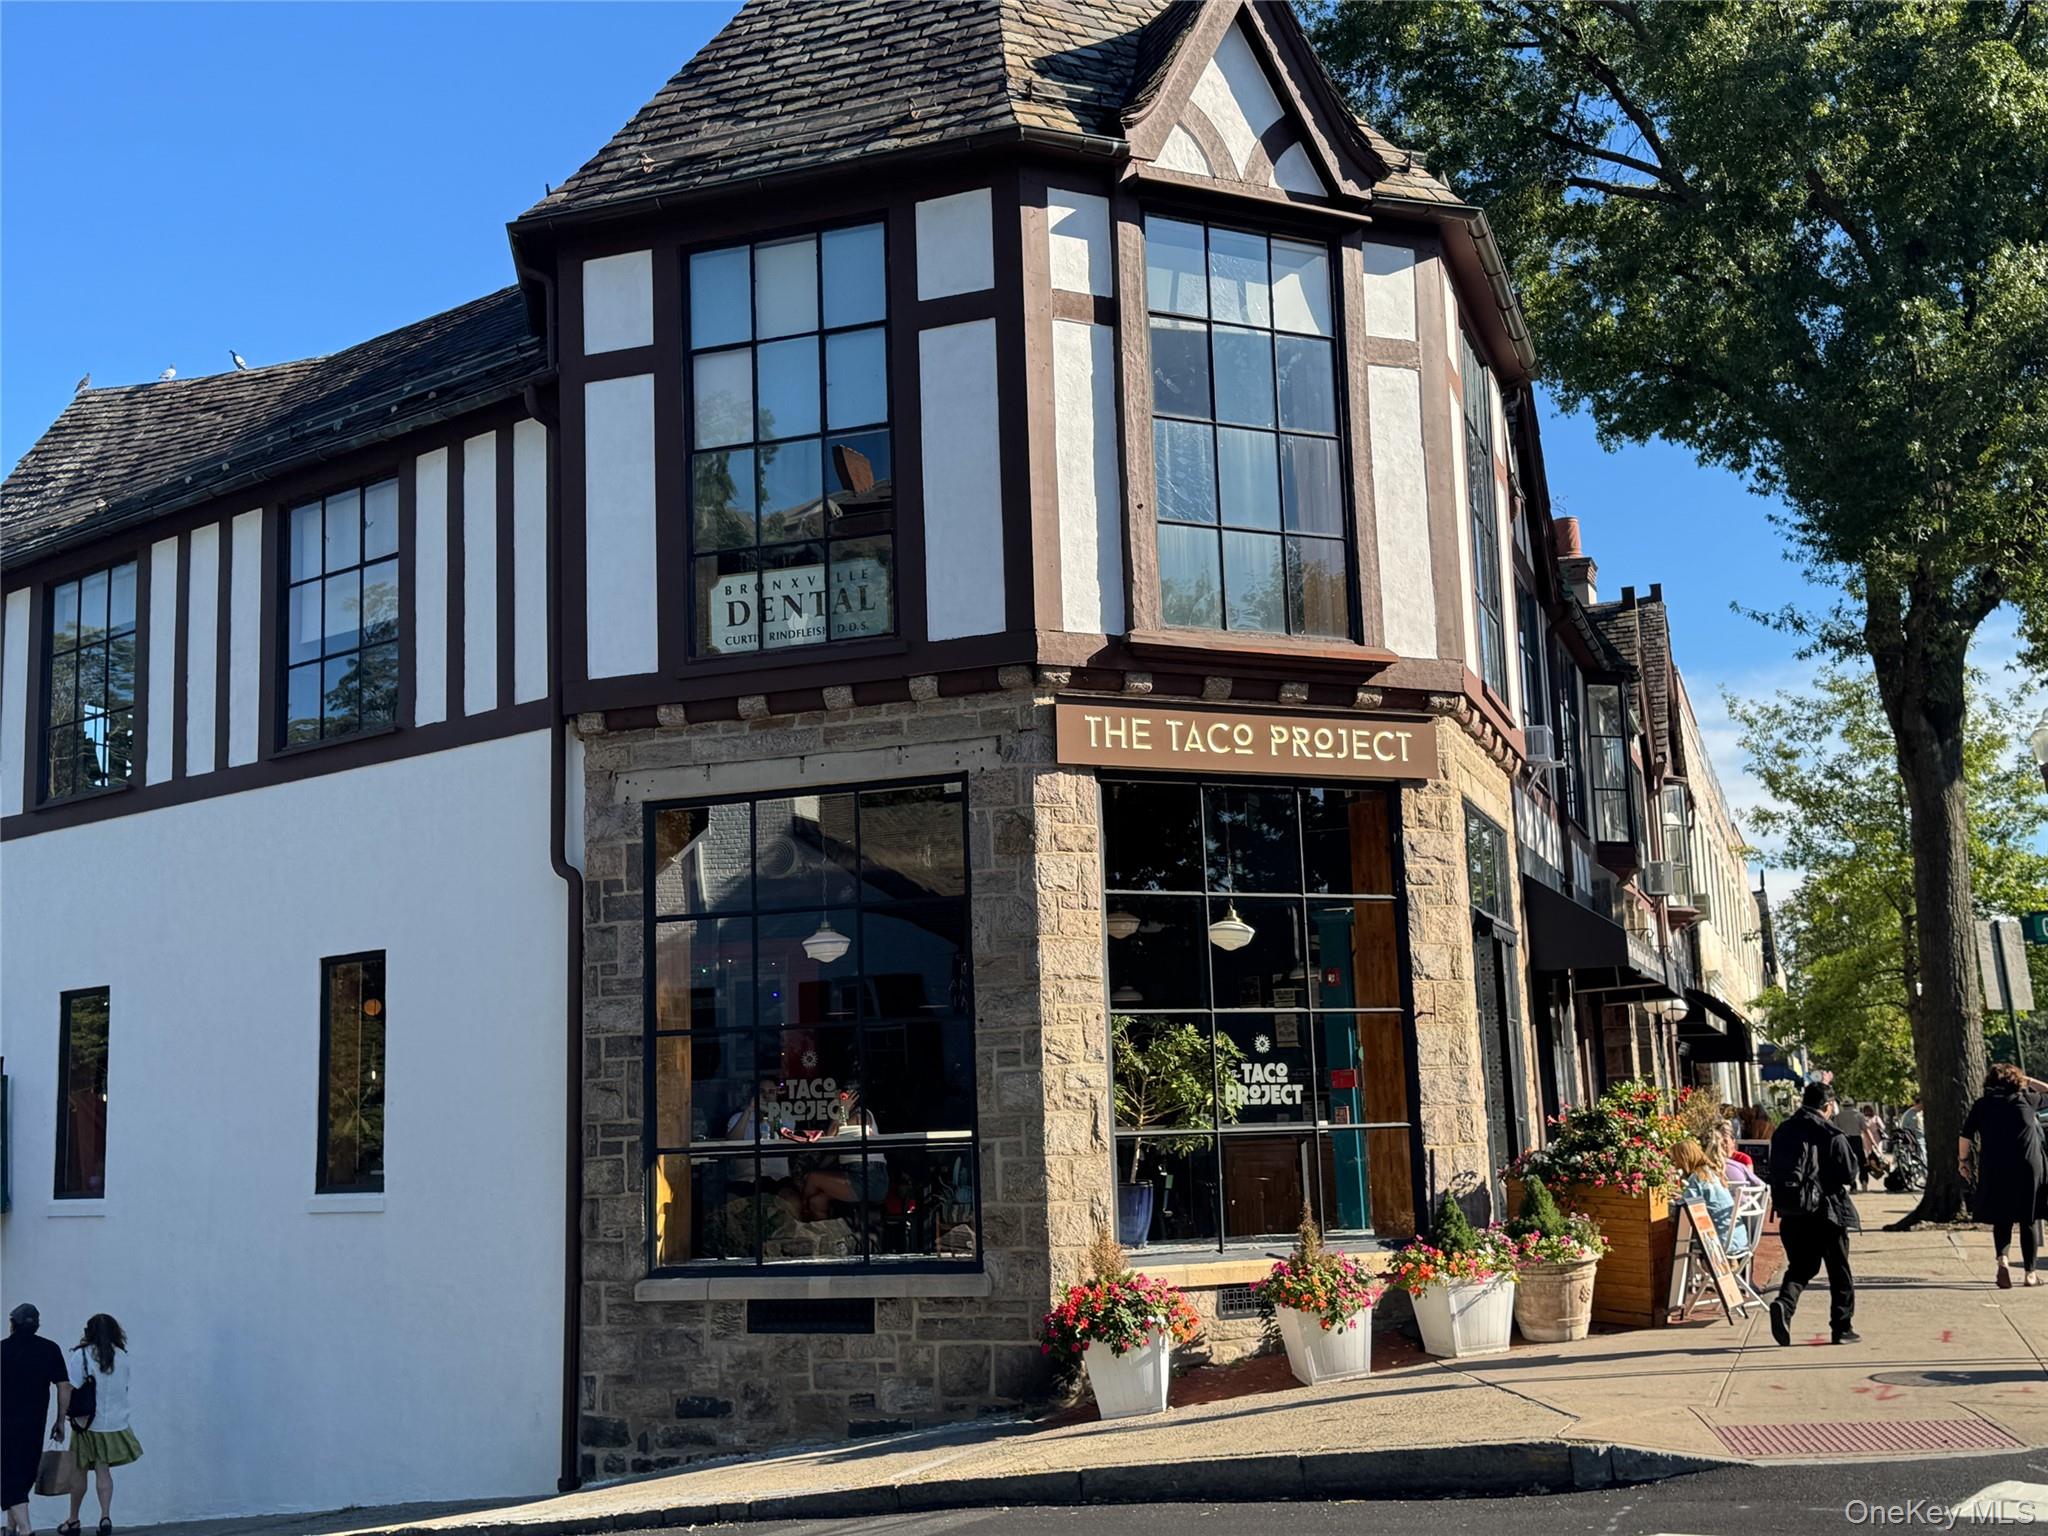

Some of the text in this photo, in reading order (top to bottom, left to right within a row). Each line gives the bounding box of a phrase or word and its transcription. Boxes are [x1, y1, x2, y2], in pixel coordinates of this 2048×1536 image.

[725, 569, 868, 596] BRONXVLLE
[726, 585, 876, 627] DENTAL
[725, 633, 761, 646] CURTI
[837, 621, 869, 634] D.D.S.
[1084, 714, 1413, 762] THE TACO PROJECT
[1241, 1062, 1289, 1083] TACO
[786, 1077, 837, 1099] TACO
[1225, 1084, 1304, 1105] PROJECT
